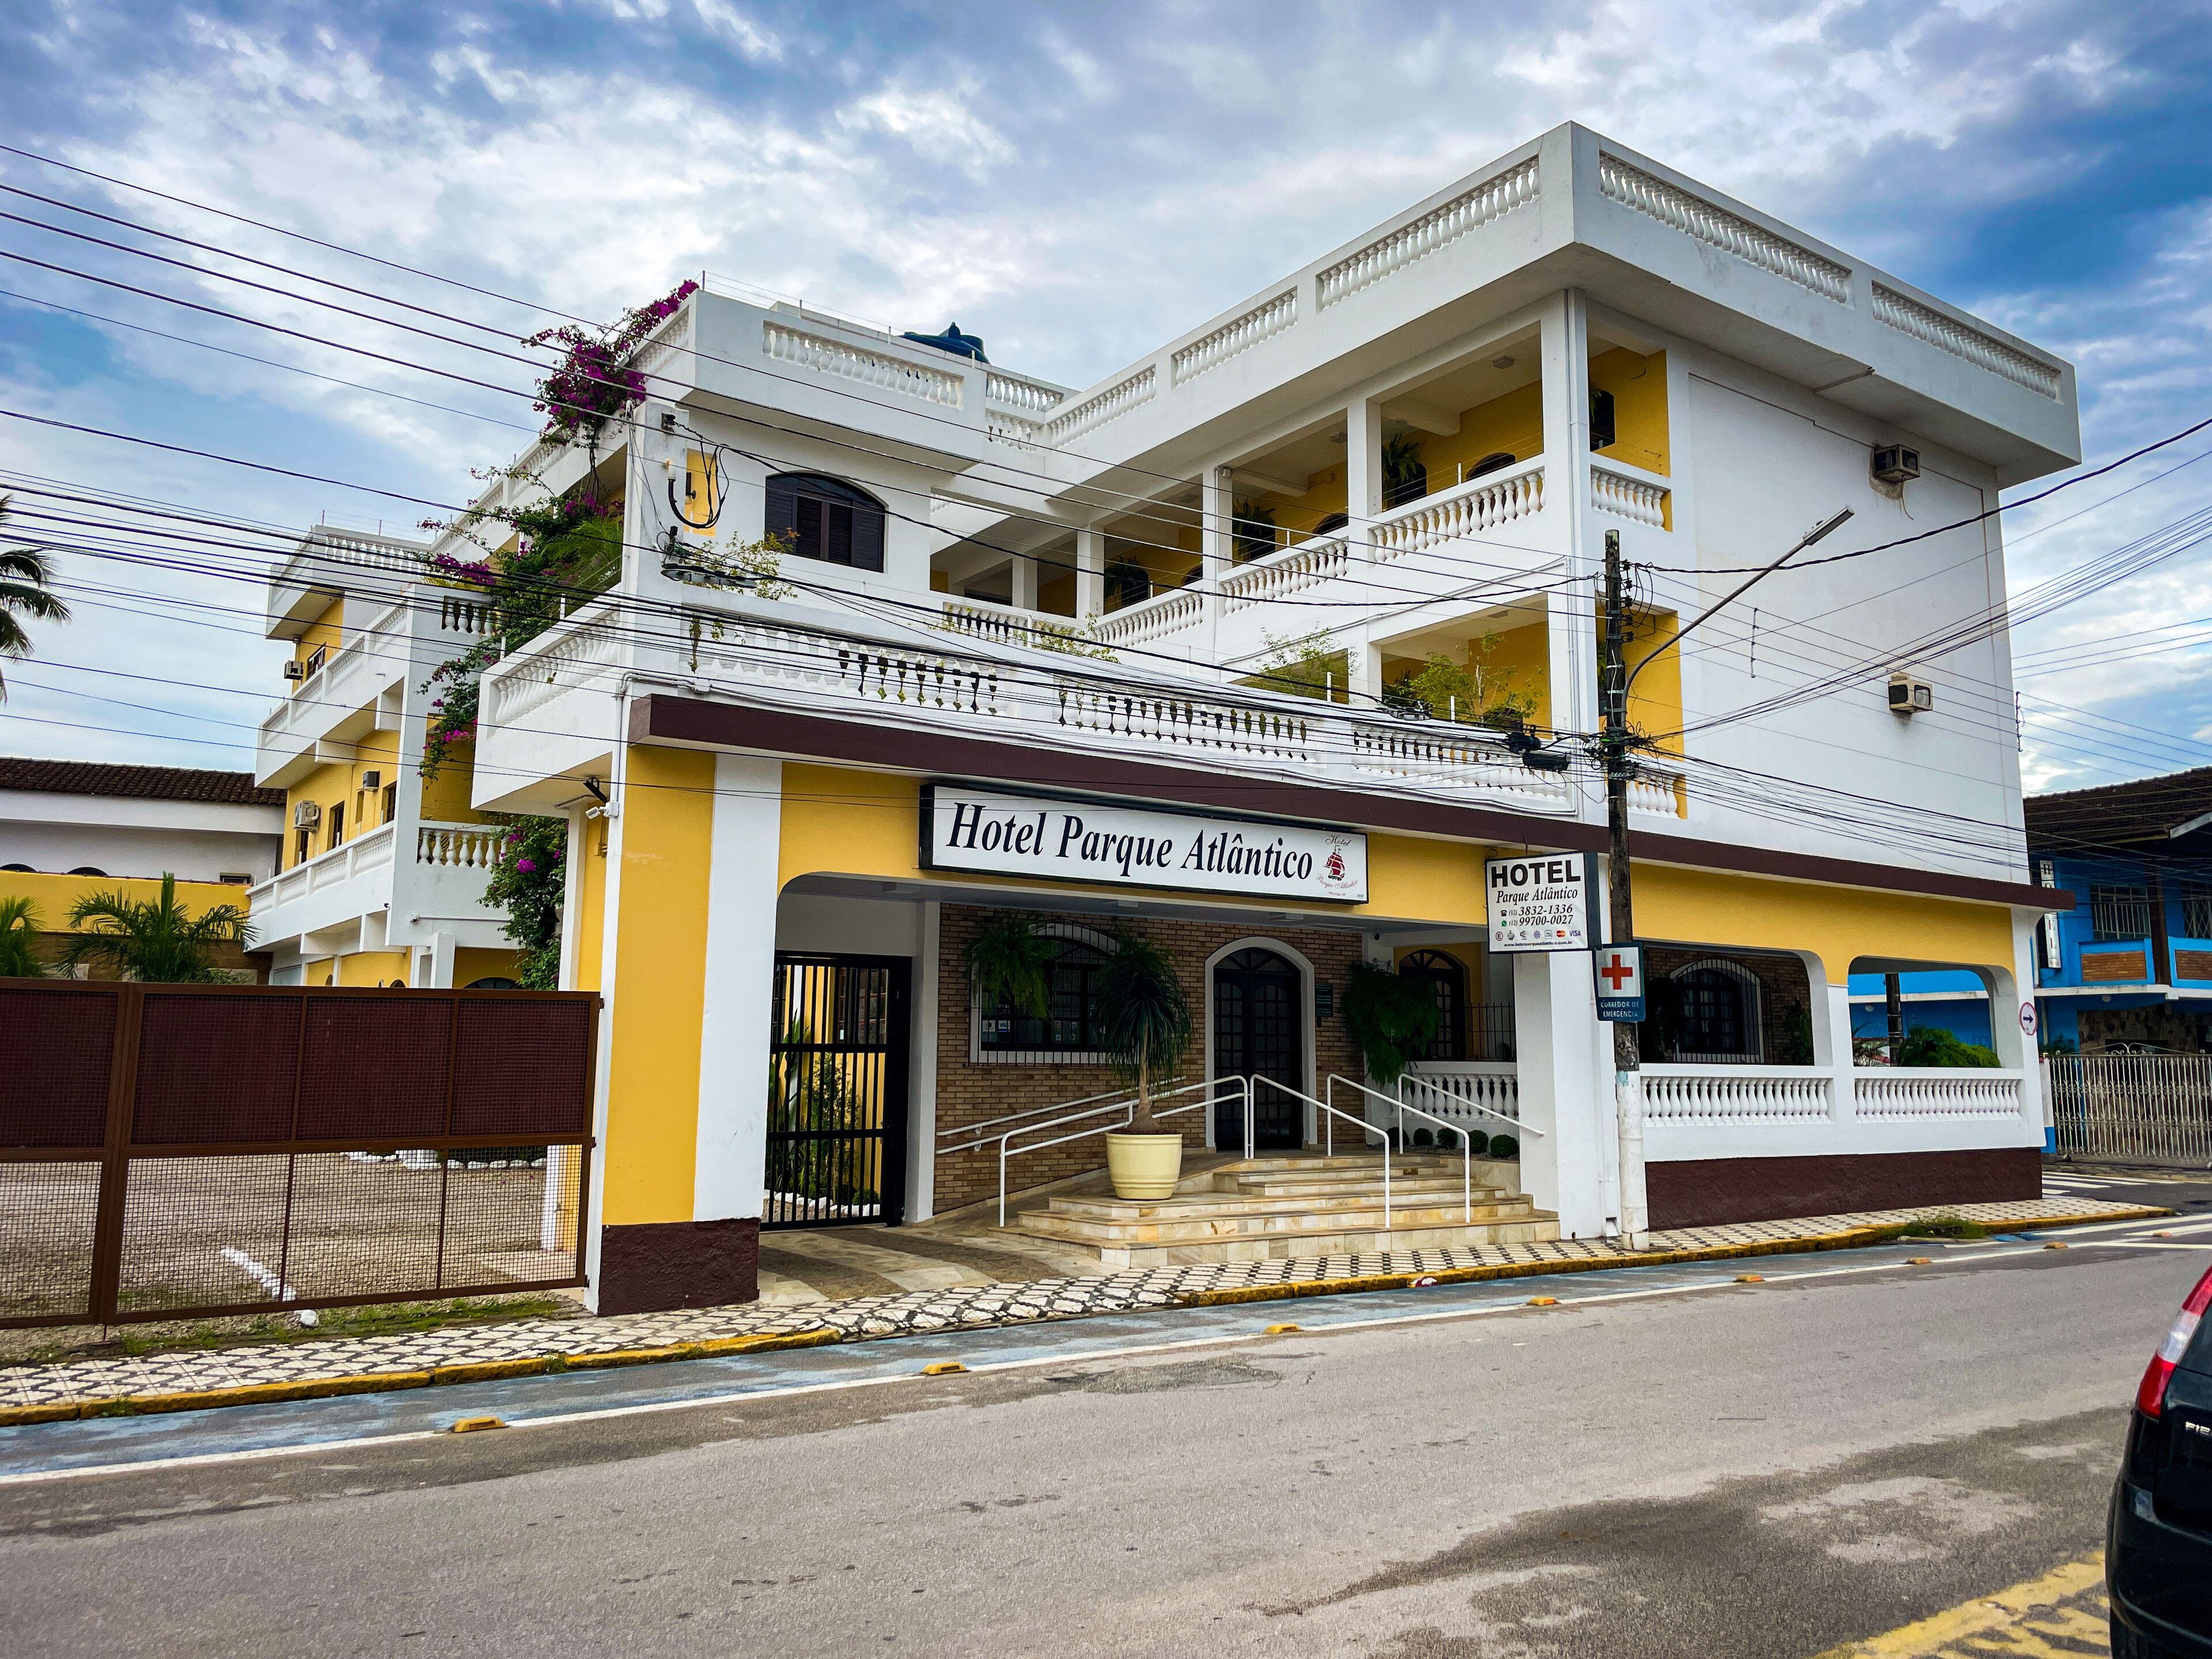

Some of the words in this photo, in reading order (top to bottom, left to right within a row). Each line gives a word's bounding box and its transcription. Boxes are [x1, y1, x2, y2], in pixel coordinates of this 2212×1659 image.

[946, 802, 1047, 855] Hotel
[1055, 815, 1173, 877] Parque
[1180, 830, 1312, 880] Atlântico
[1325, 835, 1351, 846] Hotel
[1491, 860, 1581, 888] HOTEL
[1496, 891, 1529, 906] Parque
[1532, 887, 1578, 901] Atlântico
[1518, 904, 1573, 916] 3832-1336
[1520, 915, 1573, 926] 99700-0027
[1603, 1009, 1638, 1017] EMERGÊNCIA
[2186, 1422, 2212, 1435] FIE
